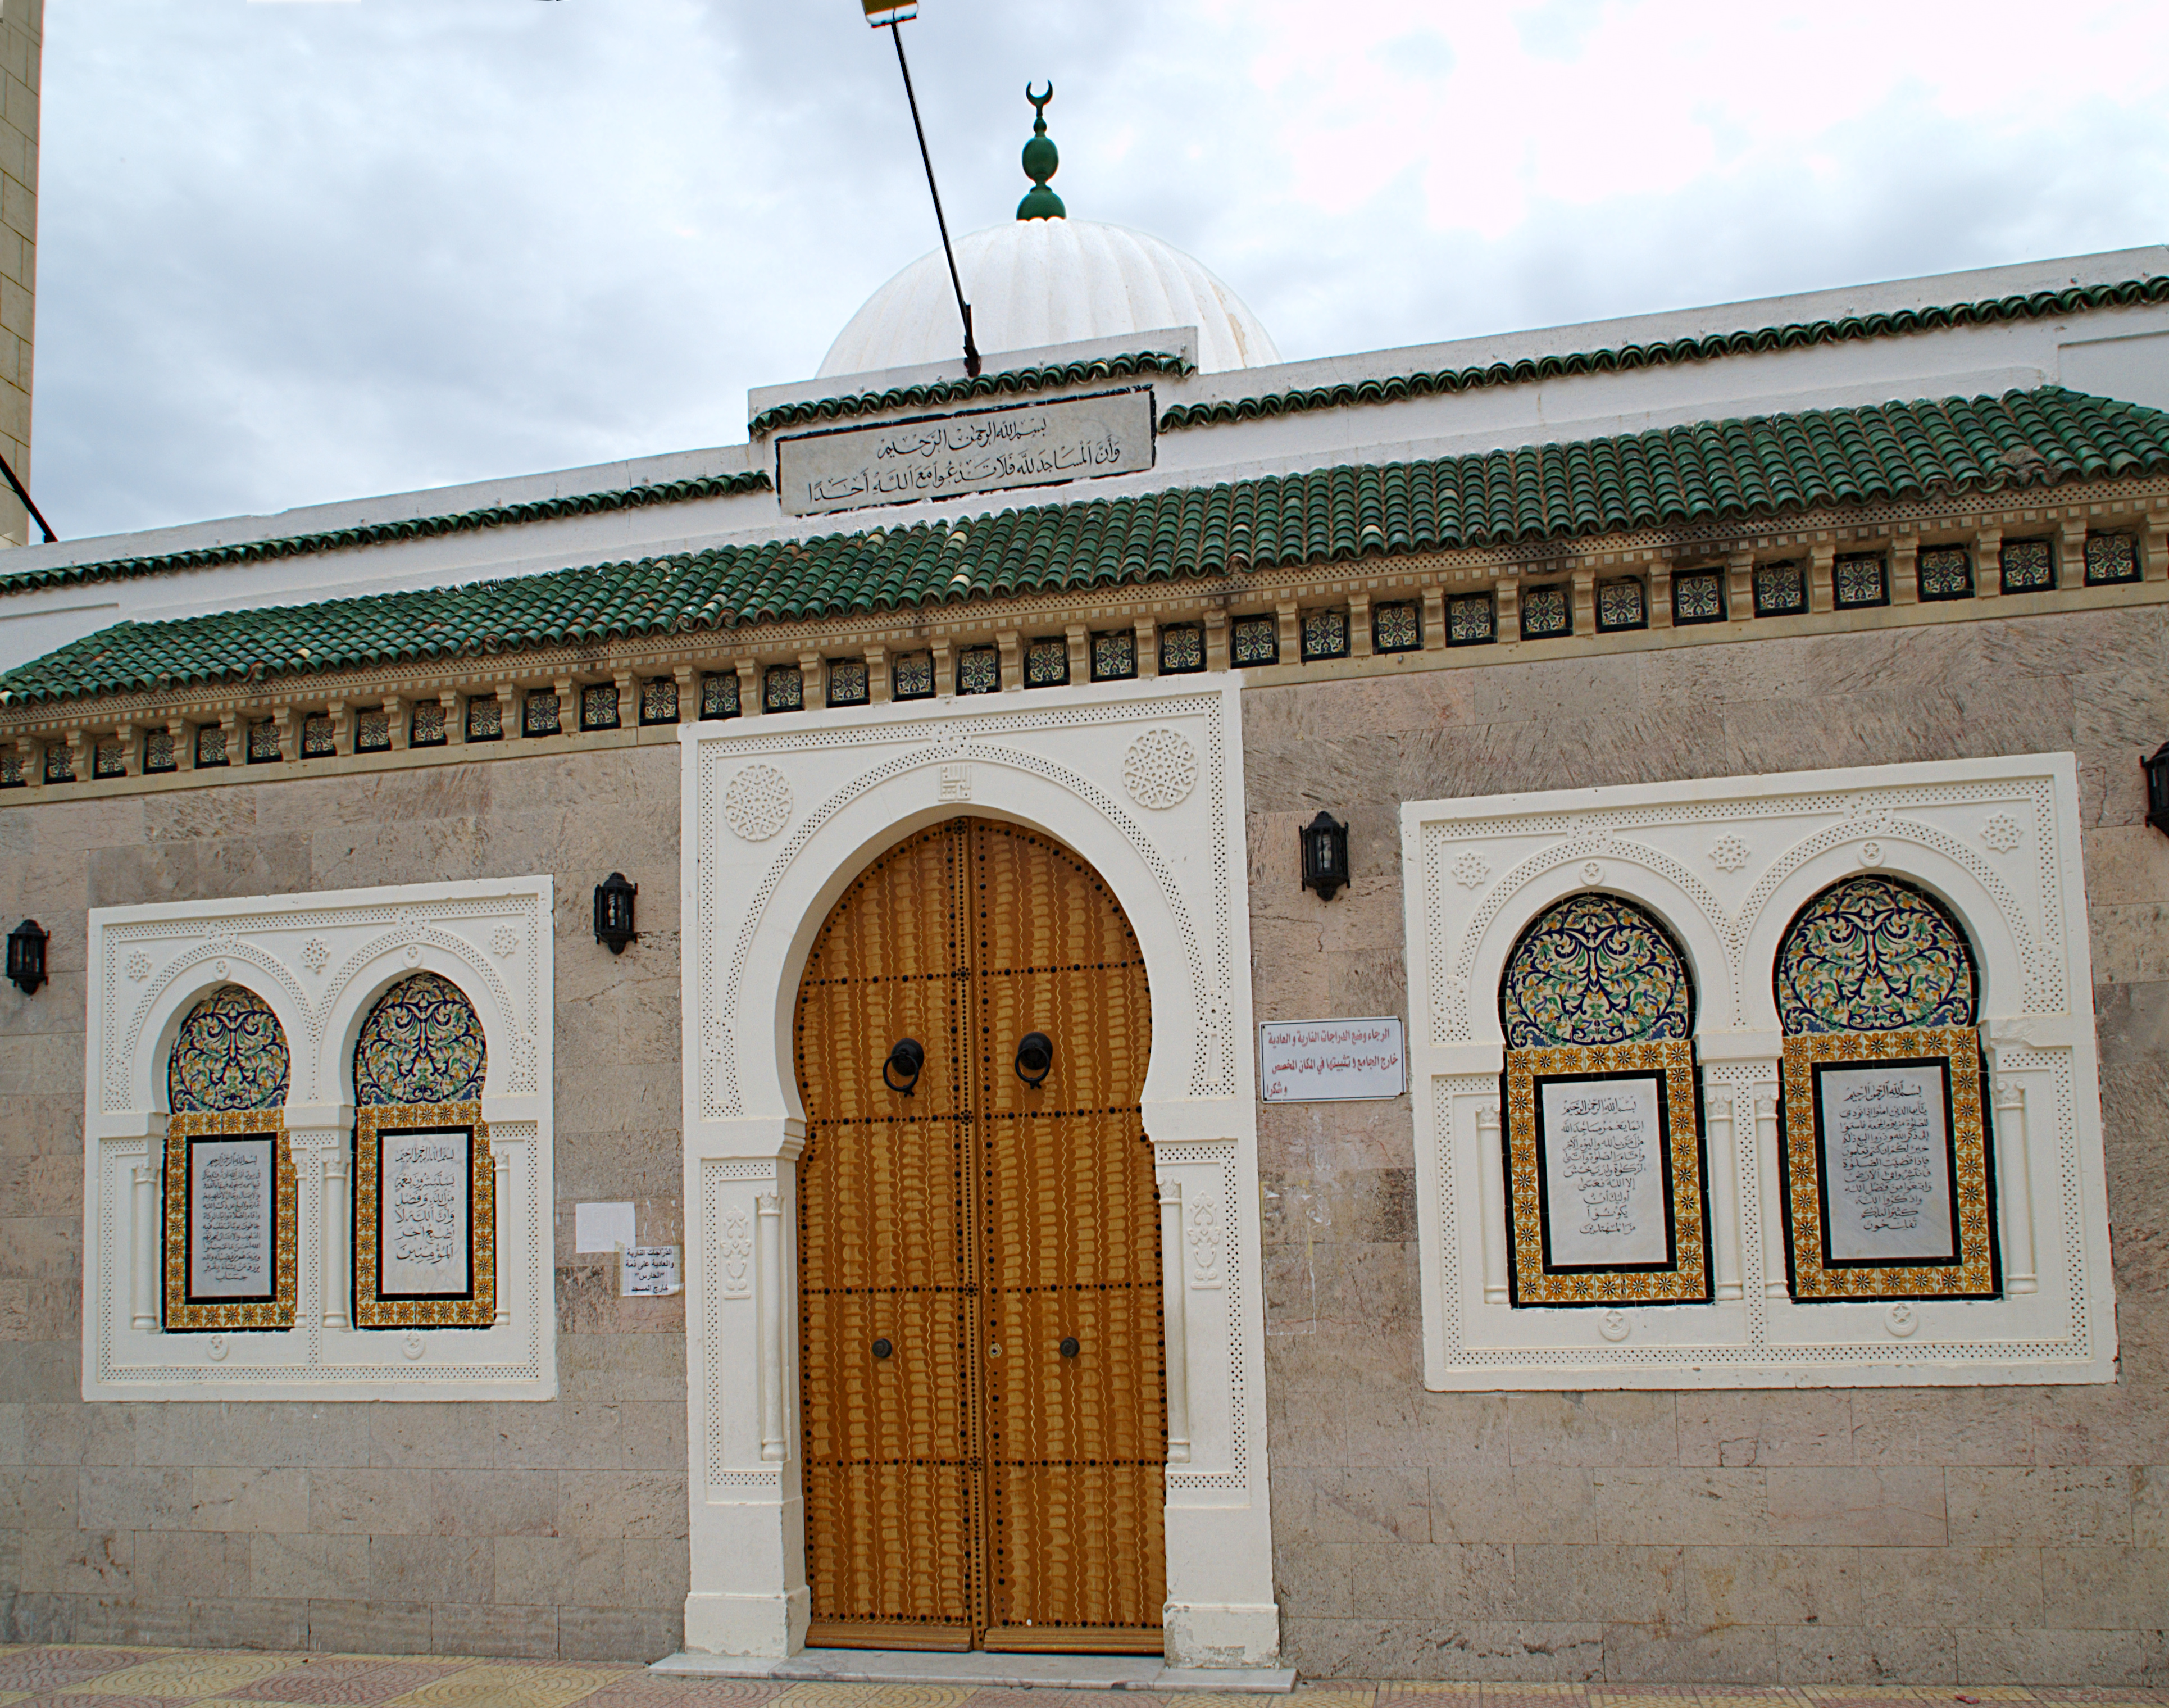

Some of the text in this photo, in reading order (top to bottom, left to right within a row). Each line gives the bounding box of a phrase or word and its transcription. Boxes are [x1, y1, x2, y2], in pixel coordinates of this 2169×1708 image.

[1268, 1028, 1390, 1049] الرجاء وضع الدراجات النارية و العادية
[1299, 1057, 1316, 1073] المكان
[1317, 1056, 1325, 1075] في
[1326, 1054, 1350, 1071] تثبيتها
[1352, 1059, 1357, 1069] و
[1357, 1055, 1380, 1071] الجامع
[1380, 1052, 1398, 1070] خارج
[1266, 1081, 1283, 1097] شكرا
[627, 1248, 645, 1258] النارية
[638, 1261, 649, 1270] على
[652, 1260, 675, 1269] والعادية
[631, 1284, 669, 1294] خارج المسجد
